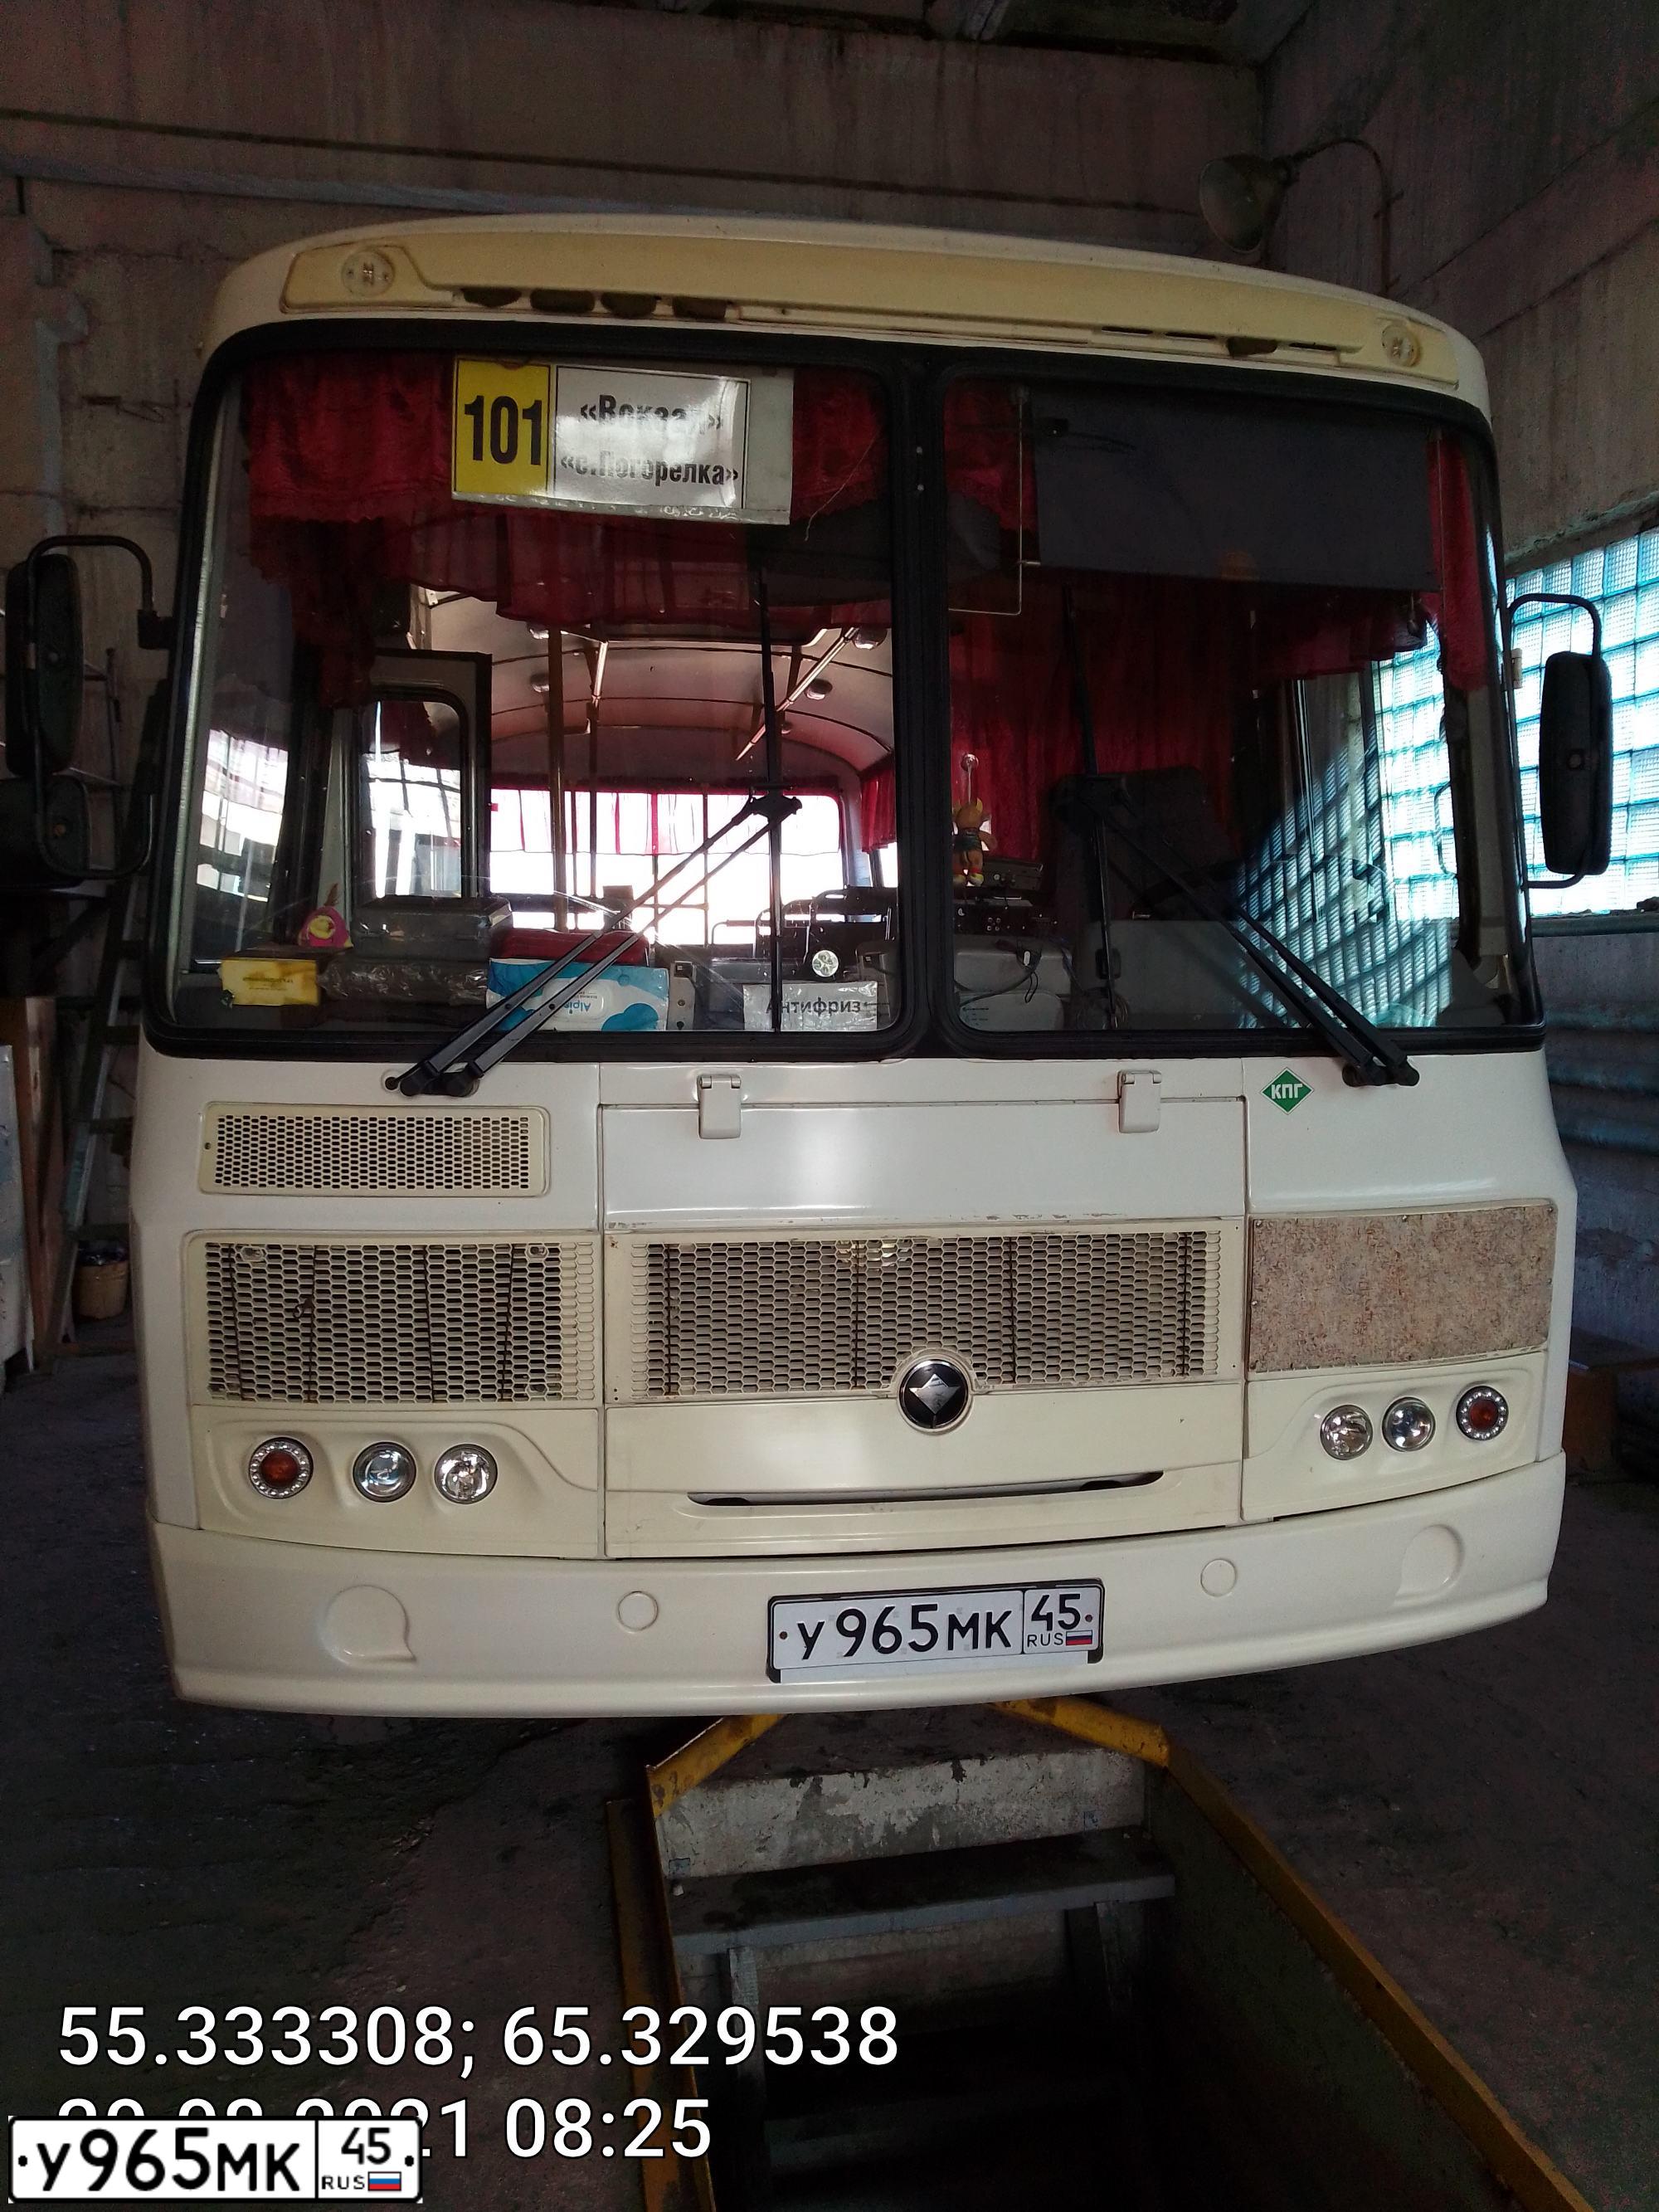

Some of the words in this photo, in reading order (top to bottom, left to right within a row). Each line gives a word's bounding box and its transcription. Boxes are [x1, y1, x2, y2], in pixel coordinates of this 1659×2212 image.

[464, 394, 542, 465] 101
[1271, 1083, 1303, 1099] КПГ
[1030, 1593, 1081, 1631] 45
[1027, 1633, 1063, 1648] RUS
